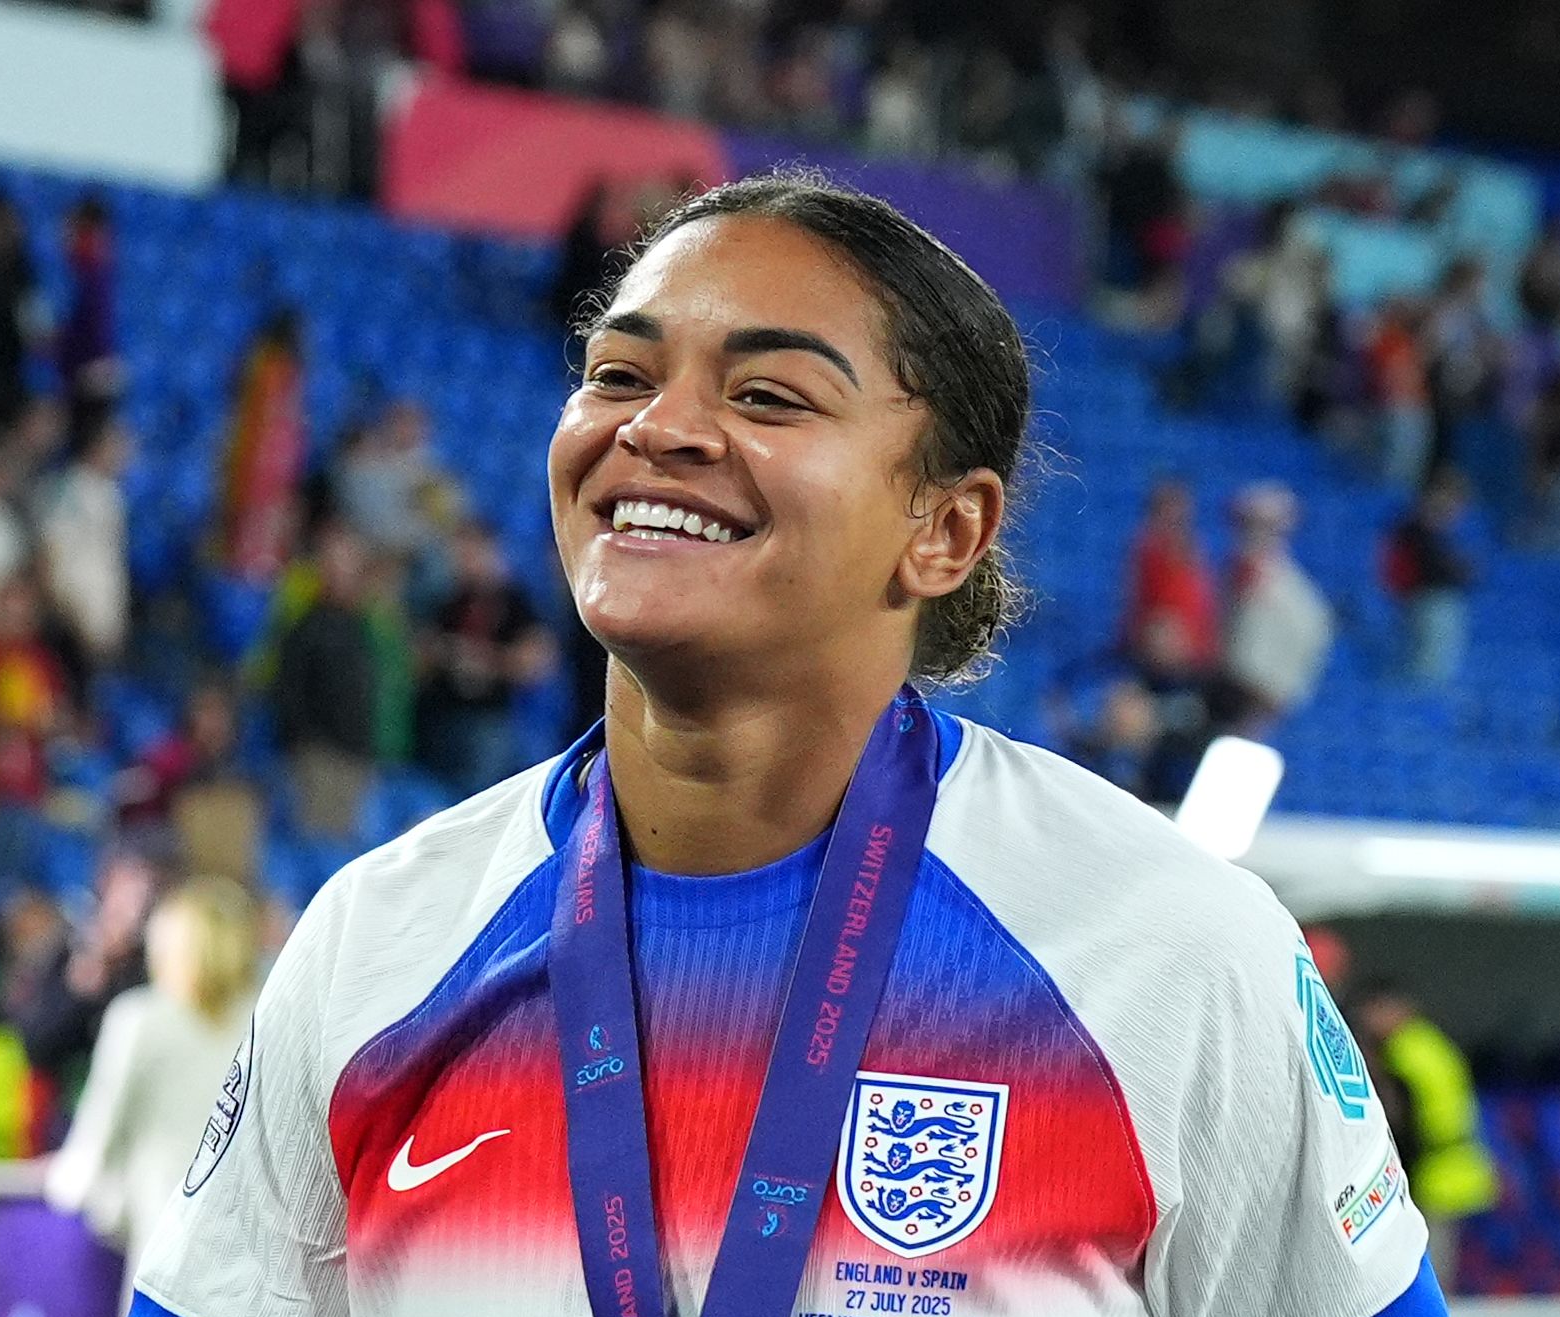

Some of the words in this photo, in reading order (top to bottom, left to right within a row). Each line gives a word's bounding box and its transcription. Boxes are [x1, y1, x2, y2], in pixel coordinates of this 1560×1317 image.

[826, 824, 893, 996] SWITZERLAND
[806, 1000, 842, 1066] 2025
[605, 1195, 629, 1262] 2025
[1333, 1184, 1356, 1213] UEFA
[1342, 1155, 1399, 1239] FOUNDAT
[835, 1261, 902, 1287] ENGLAND
[921, 1269, 968, 1290] SPAIN
[845, 1289, 865, 1309] 27
[870, 1292, 906, 1312] JULY
[911, 1295, 951, 1315] 2025
